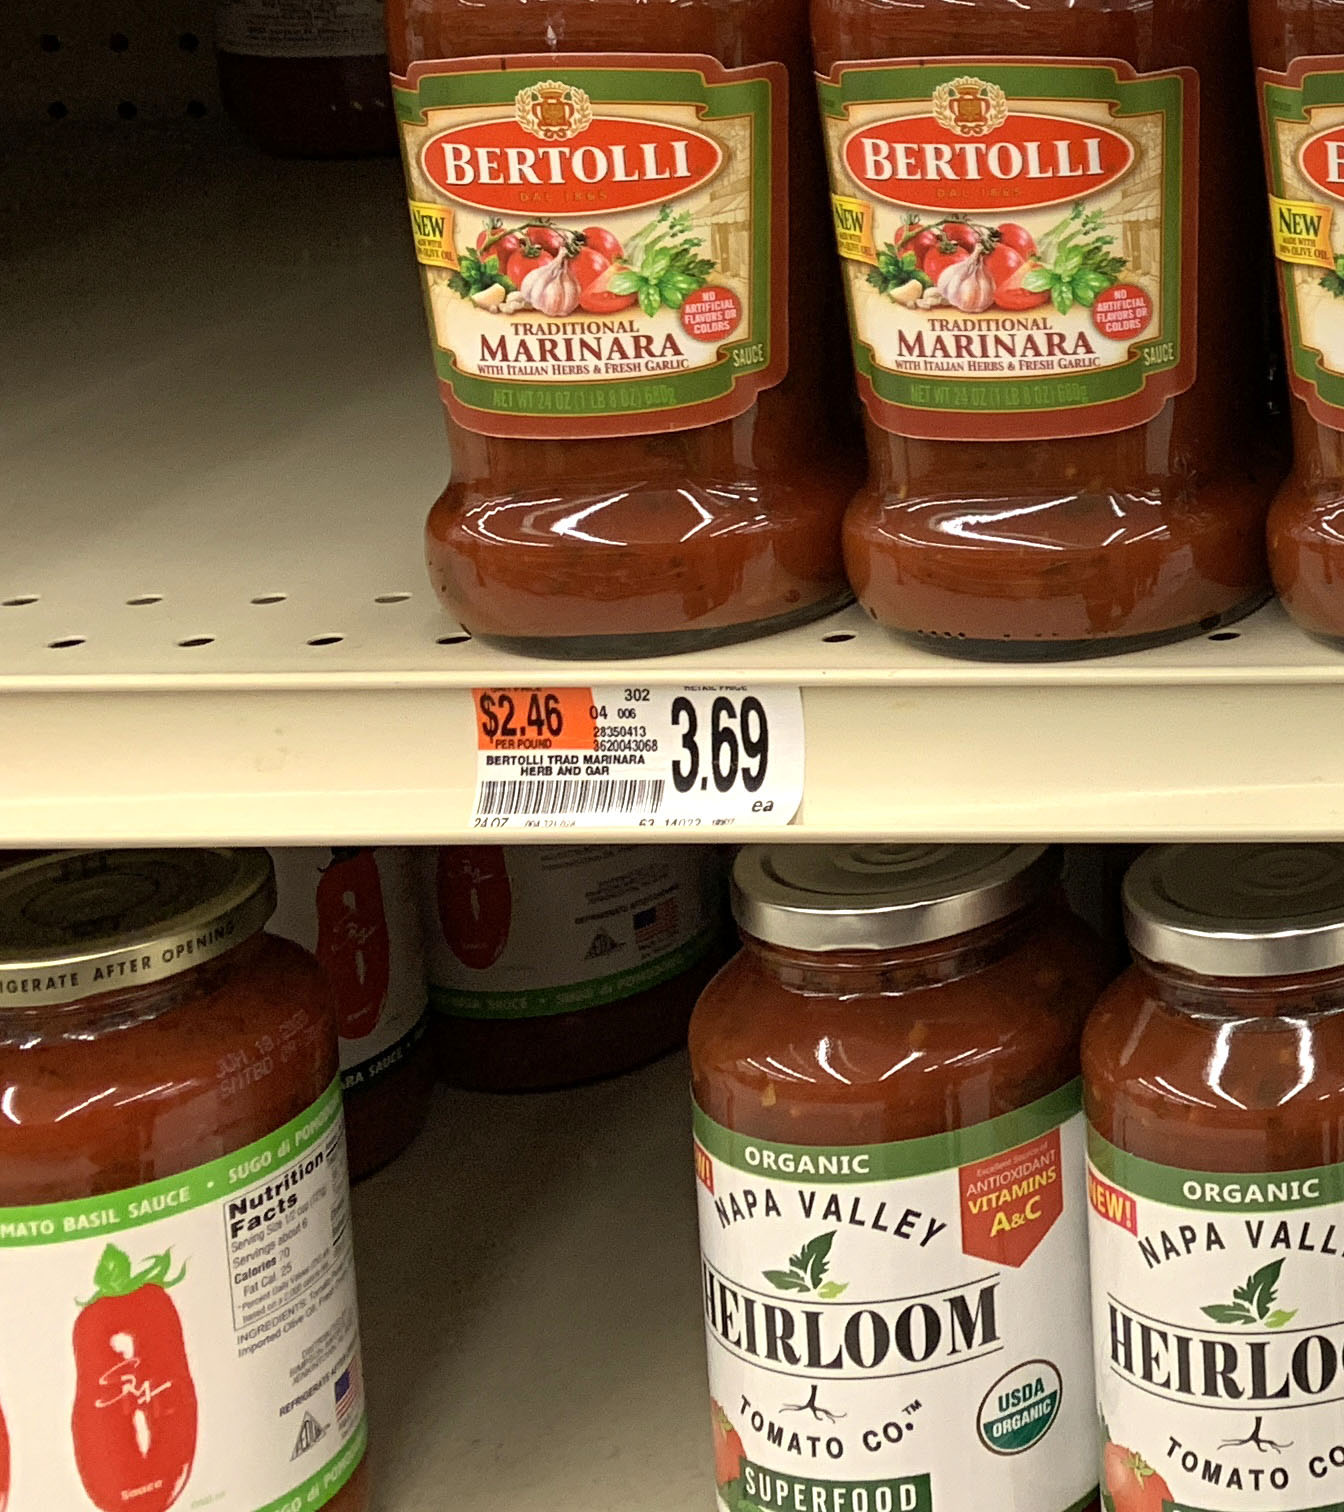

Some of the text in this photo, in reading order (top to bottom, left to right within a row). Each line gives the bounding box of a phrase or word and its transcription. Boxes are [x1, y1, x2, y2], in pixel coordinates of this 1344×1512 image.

[442, 141, 691, 185] BERTOLLI
[863, 137, 1106, 181] BERTOLLI
[1279, 207, 1322, 236] NEW
[480, 330, 685, 365] MARINARA
[511, 320, 640, 336] TRADITIONAL
[897, 327, 1094, 361] MARINARA
[480, 694, 769, 793] $2.46 3.69
[487, 756, 645, 765] BERTOLLI TRAD MARINARA
[521, 766, 609, 776] HERB AND GAR
[94, 921, 235, 982] AFTER OPENING
[745, 1147, 869, 1175] ORGANIC
[228, 1150, 325, 1221] Nutrition
[1183, 1179, 1320, 1203] ORGANIC
[63, 1187, 190, 1234] BASIL SAUCE
[230, 1193, 299, 1238] Facts
[715, 1189, 947, 1248] NAPA VALLEY
[703, 1262, 1003, 1370] HEIRLOOM
[741, 1395, 844, 1459] TOMATO
